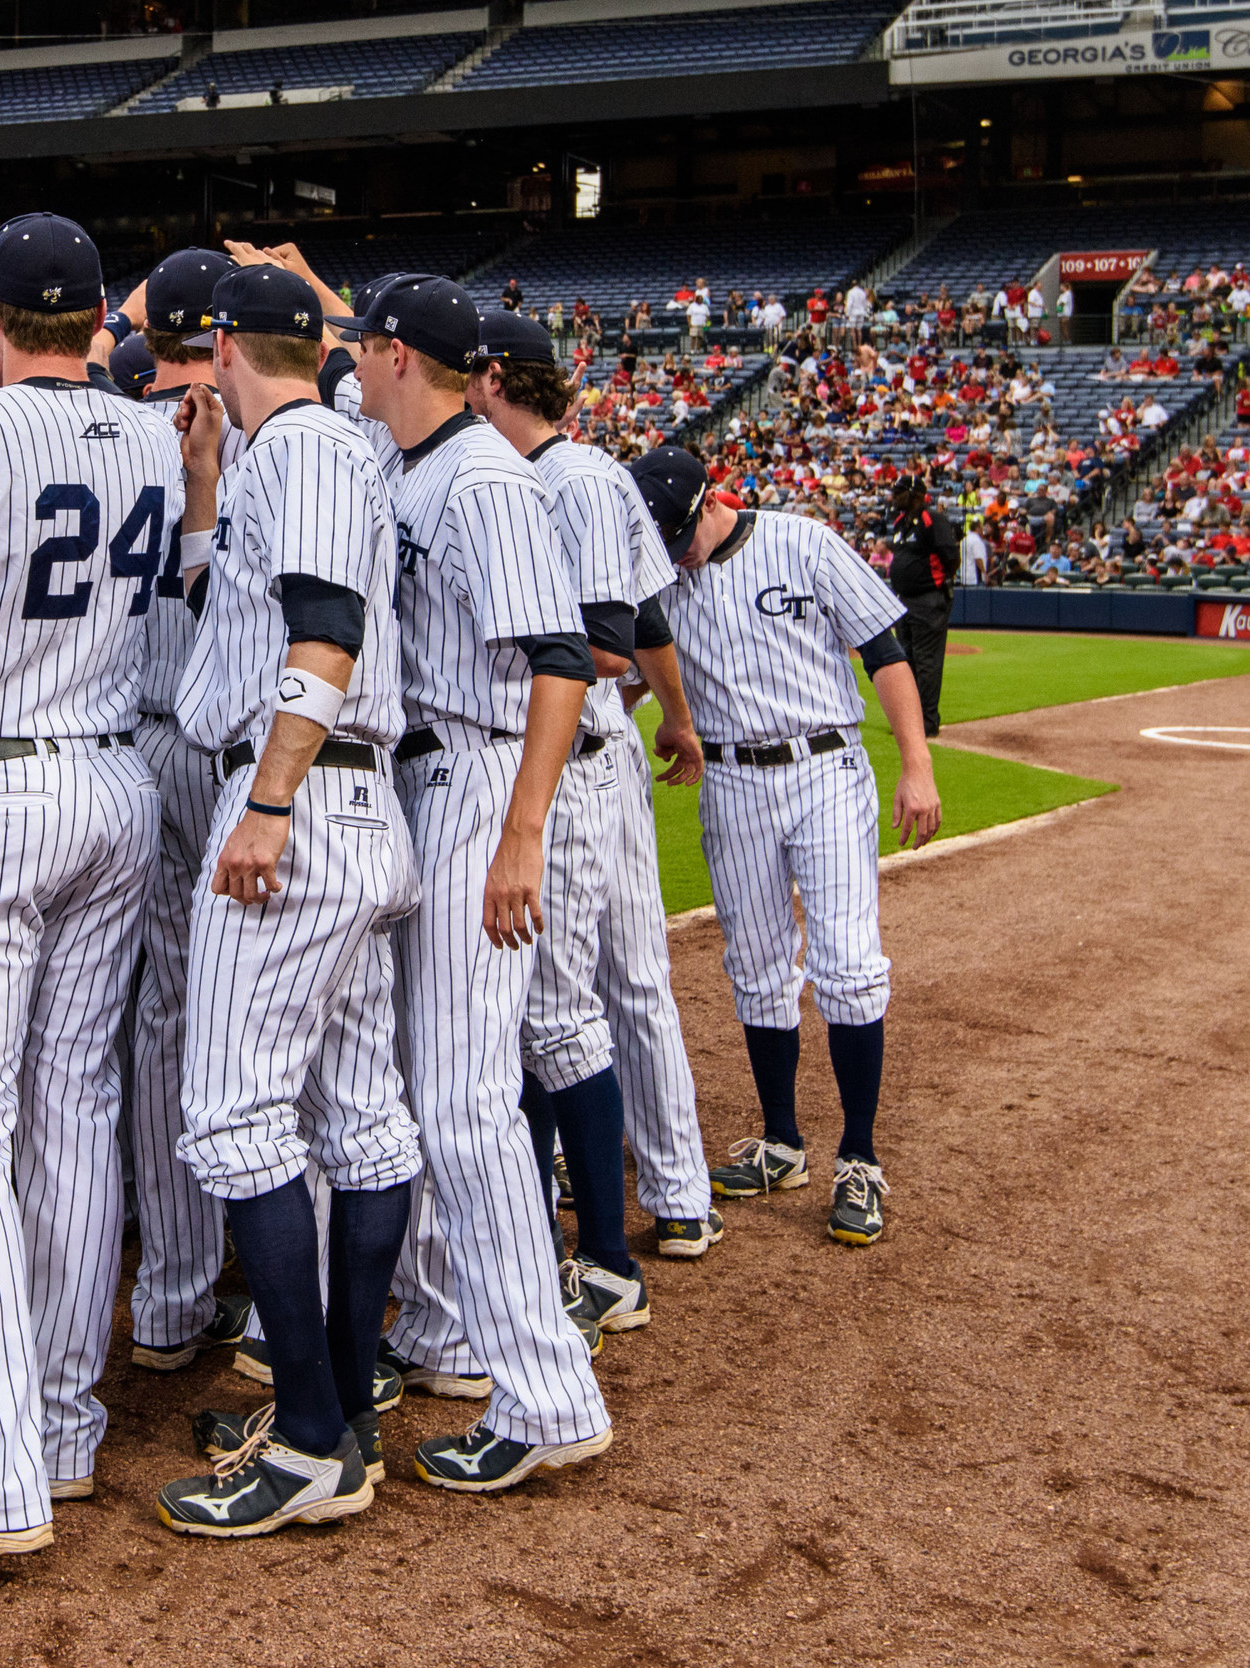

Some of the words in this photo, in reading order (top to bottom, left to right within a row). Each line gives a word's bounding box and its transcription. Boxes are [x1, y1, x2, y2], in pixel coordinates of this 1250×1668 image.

[1008, 41, 1146, 66] GEORGIA'S
[1125, 63, 1169, 73] CREDIT
[1173, 62, 1211, 71] UNION
[1061, 258, 1085, 273] 109
[1094, 257, 1118, 272] 107
[79, 423, 120, 439] ACC
[21, 483, 165, 620] 24
